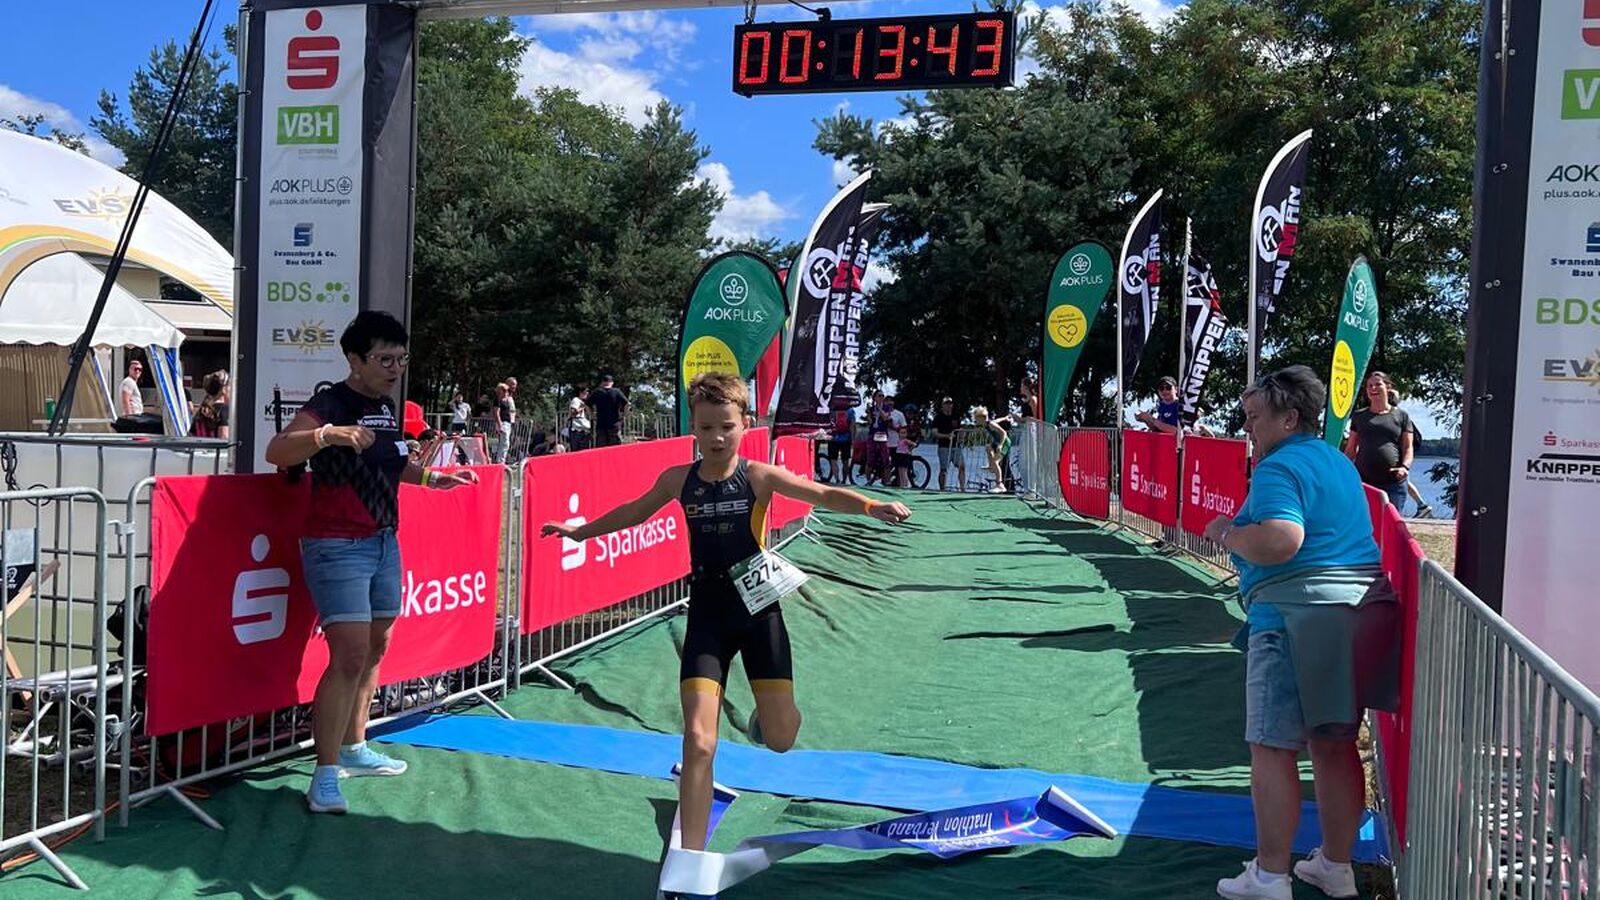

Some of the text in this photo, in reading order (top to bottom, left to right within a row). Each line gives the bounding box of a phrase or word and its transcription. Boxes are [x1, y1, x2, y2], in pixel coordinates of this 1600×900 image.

[739, 19, 1004, 85] 00:13:43
[282, 112, 333, 137] VBH
[1544, 189, 1600, 199] plus.aok.
[53, 197, 134, 214] EVS
[1572, 269, 1594, 277] Bau
[267, 282, 312, 302] BDS
[272, 328, 335, 343] EVSE
[1544, 359, 1600, 377] EV
[595, 516, 677, 568] Sparkasse
[742, 559, 783, 591] E274
[400, 570, 487, 618] kasse
